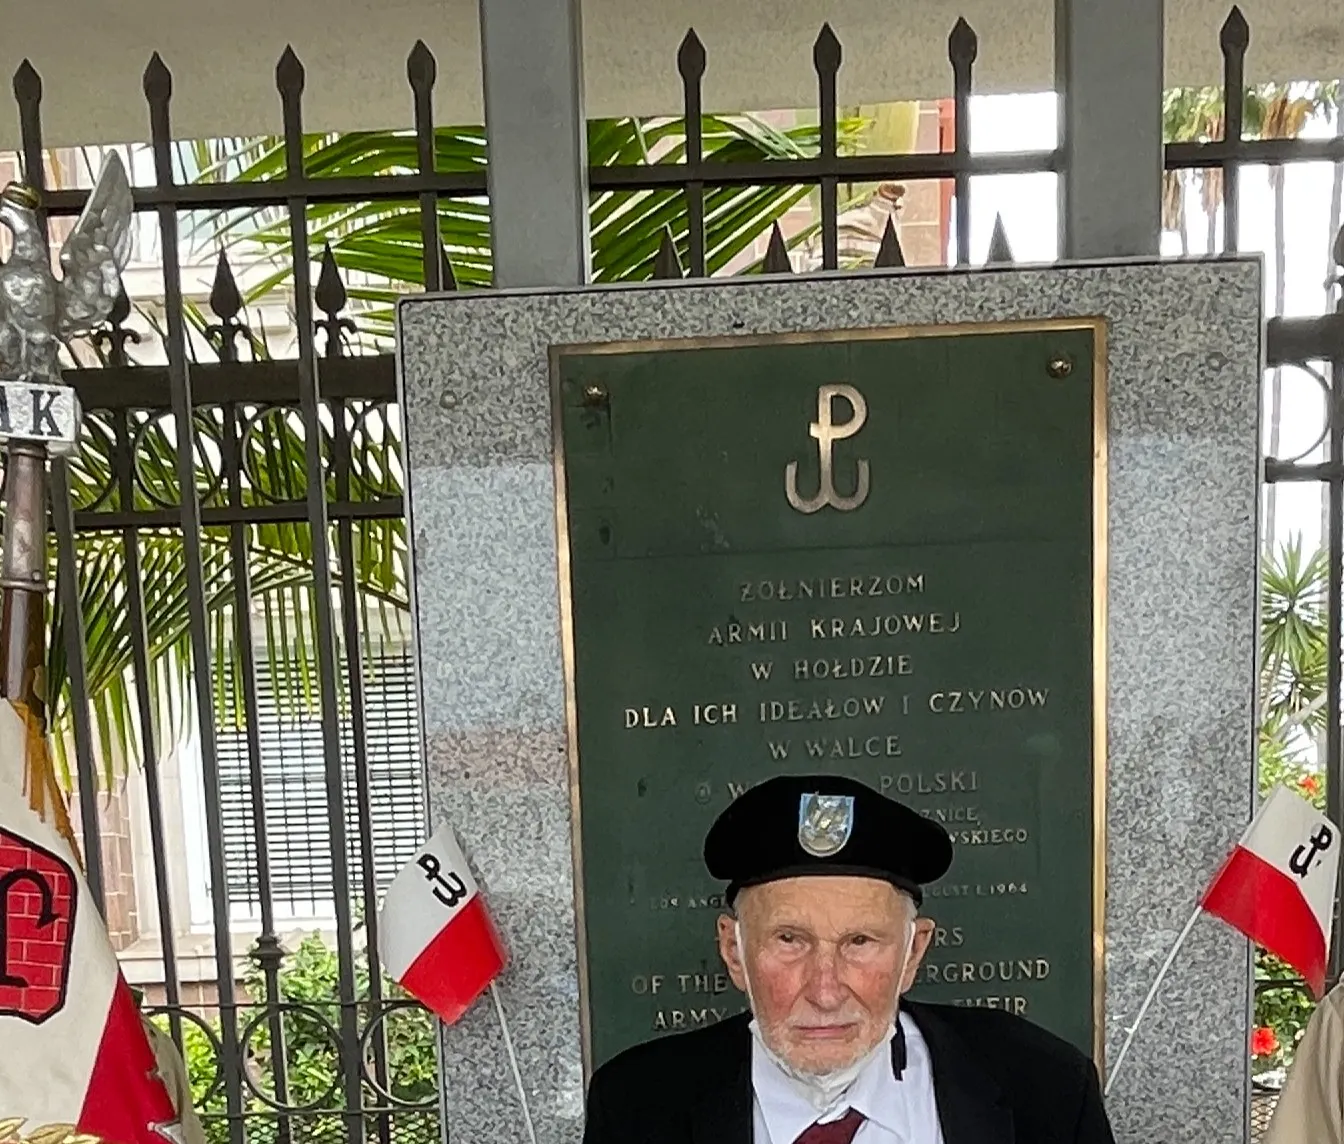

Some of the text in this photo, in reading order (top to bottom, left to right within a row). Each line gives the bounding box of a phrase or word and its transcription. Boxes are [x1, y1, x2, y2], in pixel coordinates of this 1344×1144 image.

[708, 612, 962, 646] ARMII KRAJOWEJ
[751, 654, 914, 681] W HOŁDZIE
[625, 706, 677, 729] DLA
[693, 702, 738, 725] ICH
[902, 694, 910, 716] I
[769, 735, 903, 760] W WALCE
[880, 770, 980, 794] POLSKI
[631, 972, 729, 995] OF THE
[653, 1007, 728, 1031] ARMY
